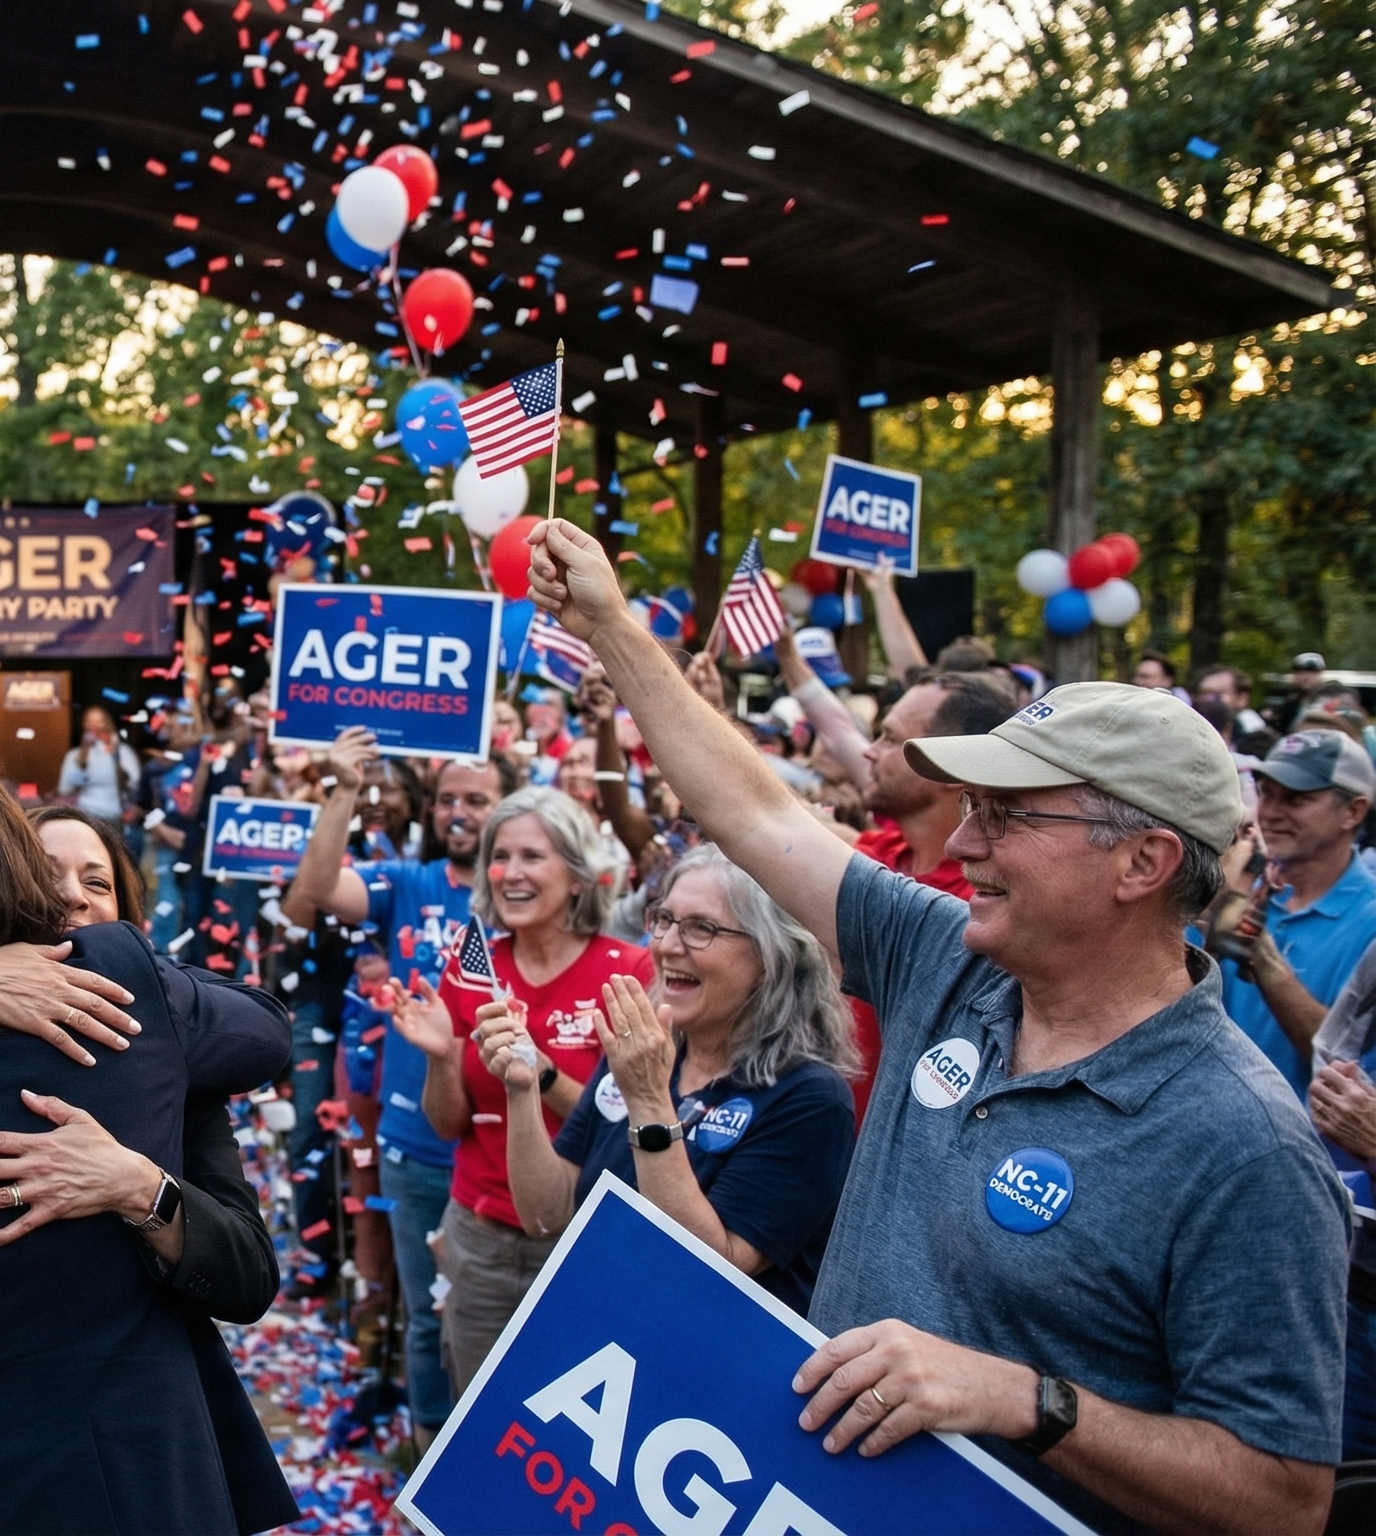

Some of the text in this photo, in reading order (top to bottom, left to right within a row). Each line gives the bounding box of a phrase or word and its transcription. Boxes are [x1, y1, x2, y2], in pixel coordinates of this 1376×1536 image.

[826, 486, 910, 534] AGER
[28, 597, 119, 620] PARTY
[288, 629, 471, 689] AGER
[288, 683, 468, 715] FOR CONGRESS
[927, 1048, 971, 1092] AGER
[704, 1107, 748, 1129] NC-11
[997, 1158, 1068, 1210] NC-11
[495, 1421, 596, 1530] FOR
